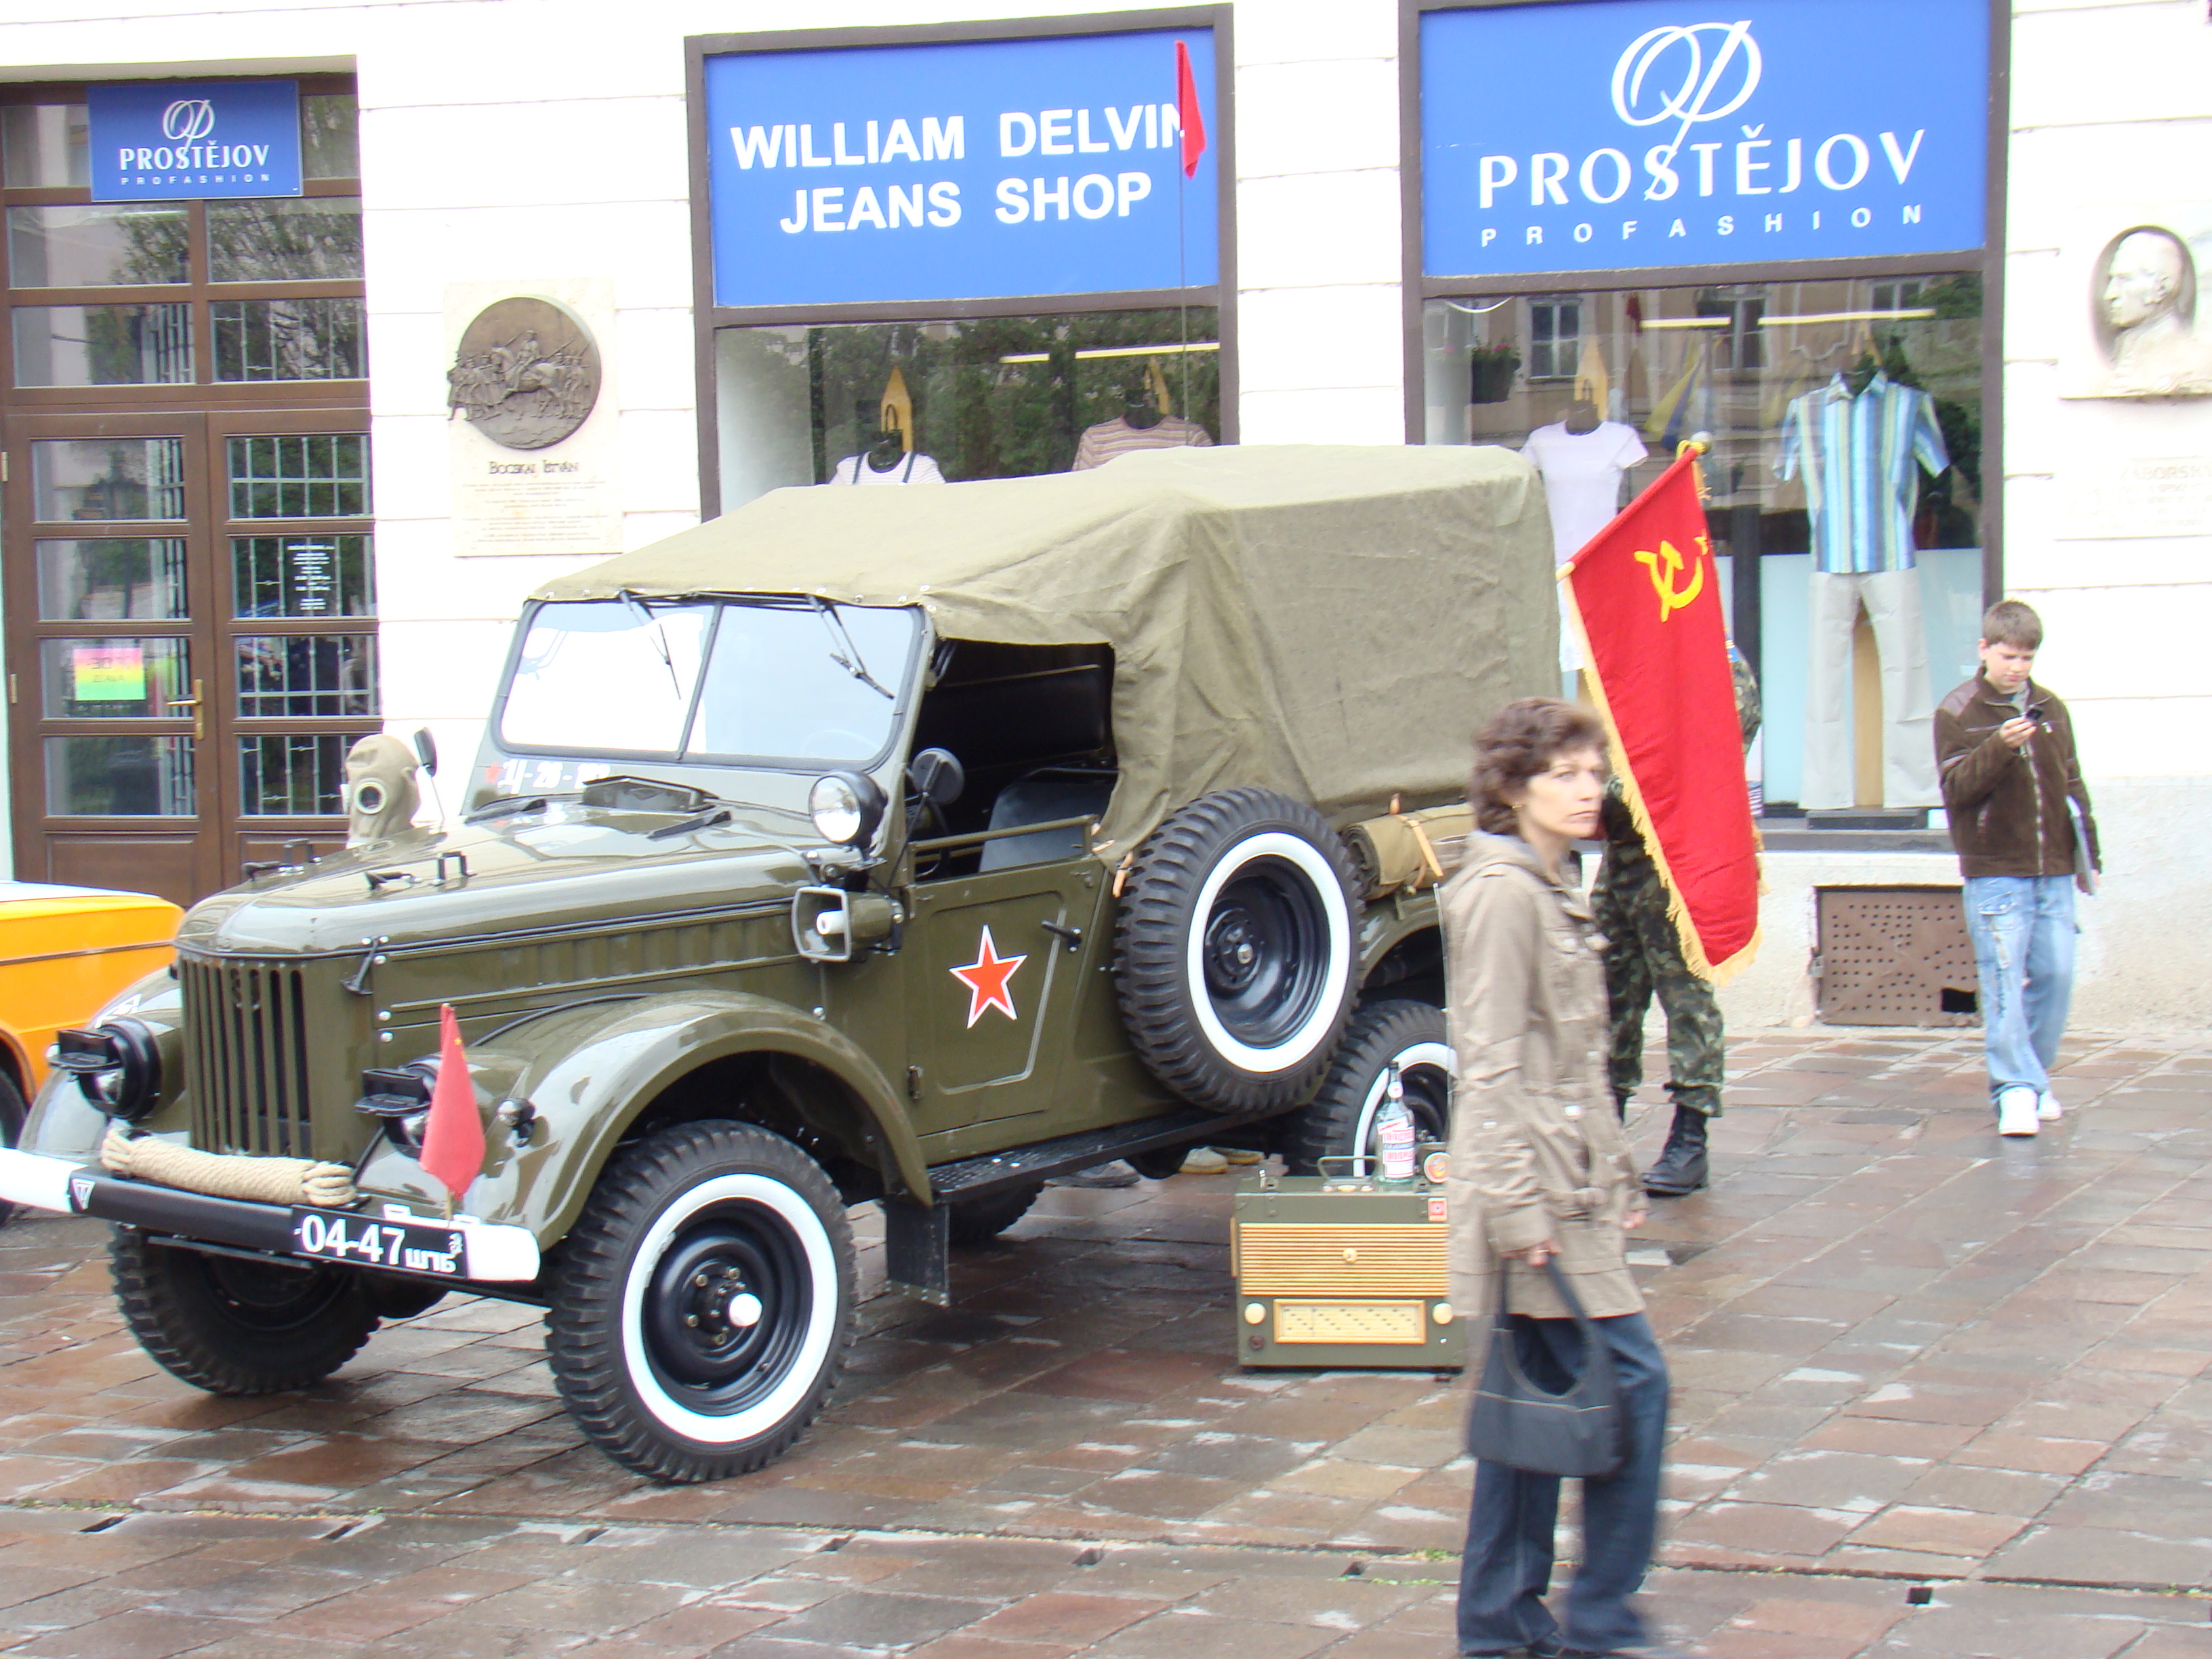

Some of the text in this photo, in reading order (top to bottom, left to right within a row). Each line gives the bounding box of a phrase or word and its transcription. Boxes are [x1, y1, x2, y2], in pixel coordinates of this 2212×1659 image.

[119, 140, 270, 171] PROSTĚJOV
[730, 115, 965, 169] WILLIAM
[1479, 123, 1925, 209] PROSTĚJOV
[120, 173, 270, 186] PROFASHION
[779, 171, 1151, 234] JEANS SHOP
[1479, 203, 1921, 248] PROFASHION
[302, 1214, 406, 1265] 04-47
